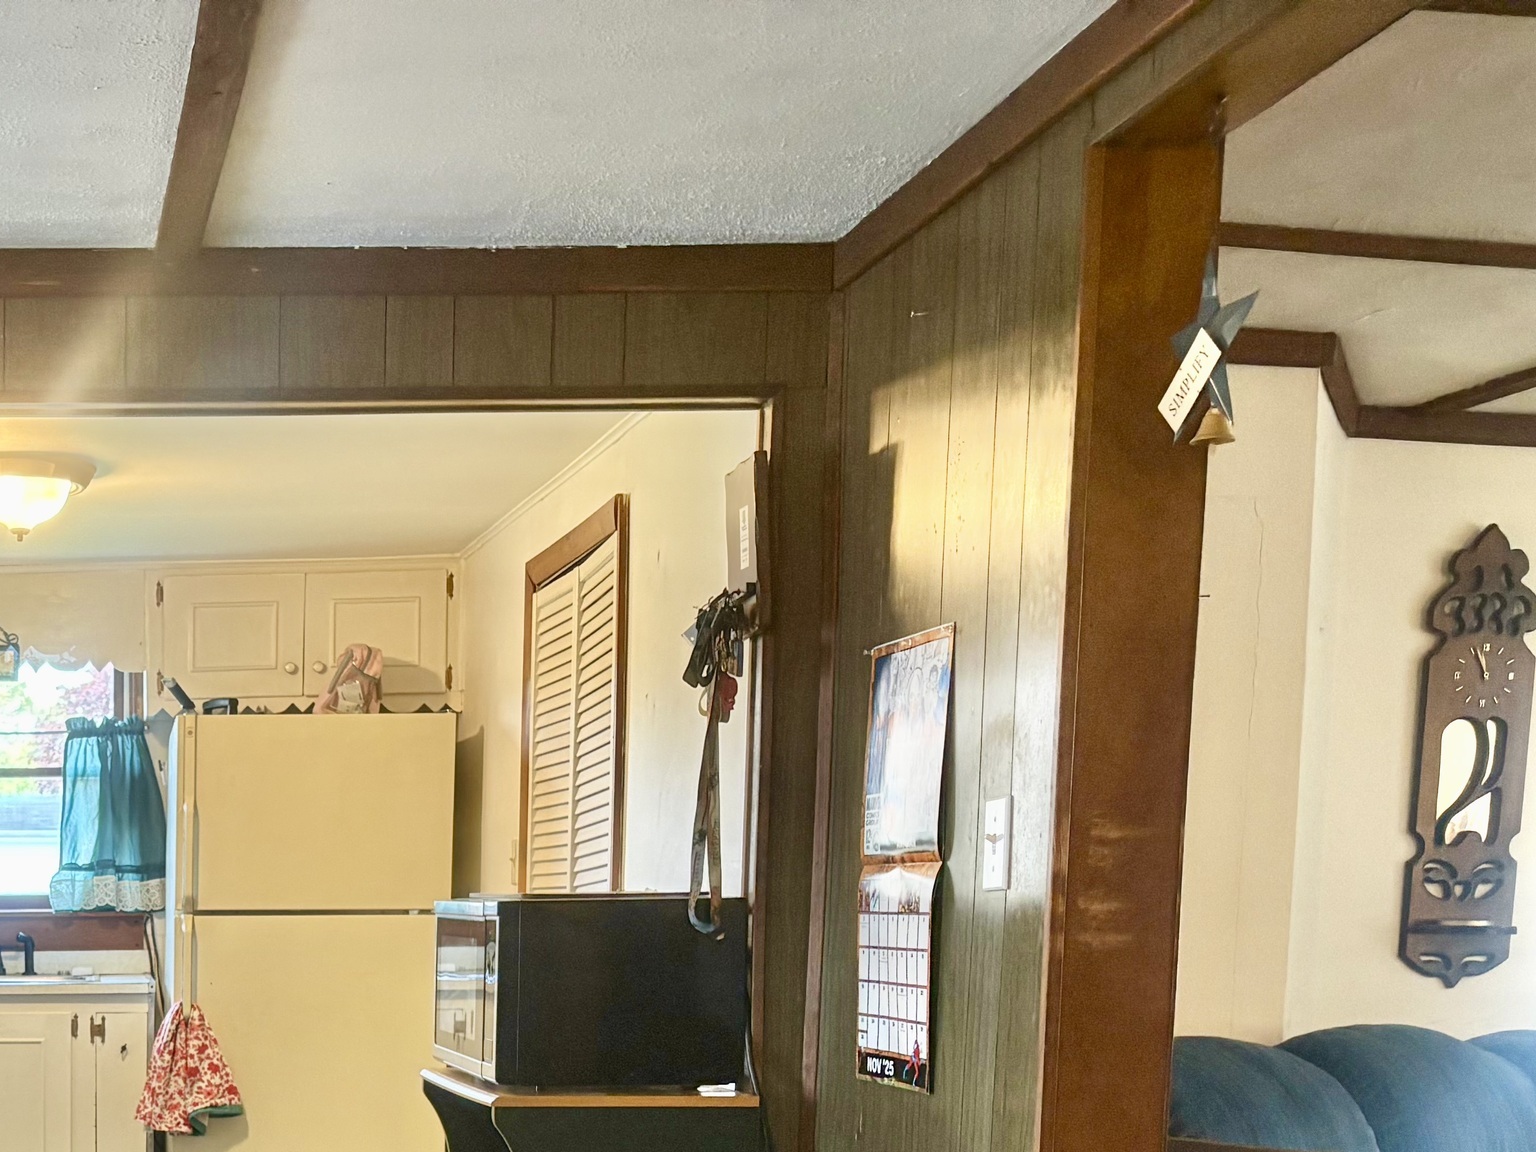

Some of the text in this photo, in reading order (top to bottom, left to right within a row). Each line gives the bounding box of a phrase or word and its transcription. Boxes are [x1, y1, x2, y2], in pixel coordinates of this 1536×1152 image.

[1168, 345, 1209, 417] SIMPLIFY
[866, 1056, 894, 1076] NOV '25
